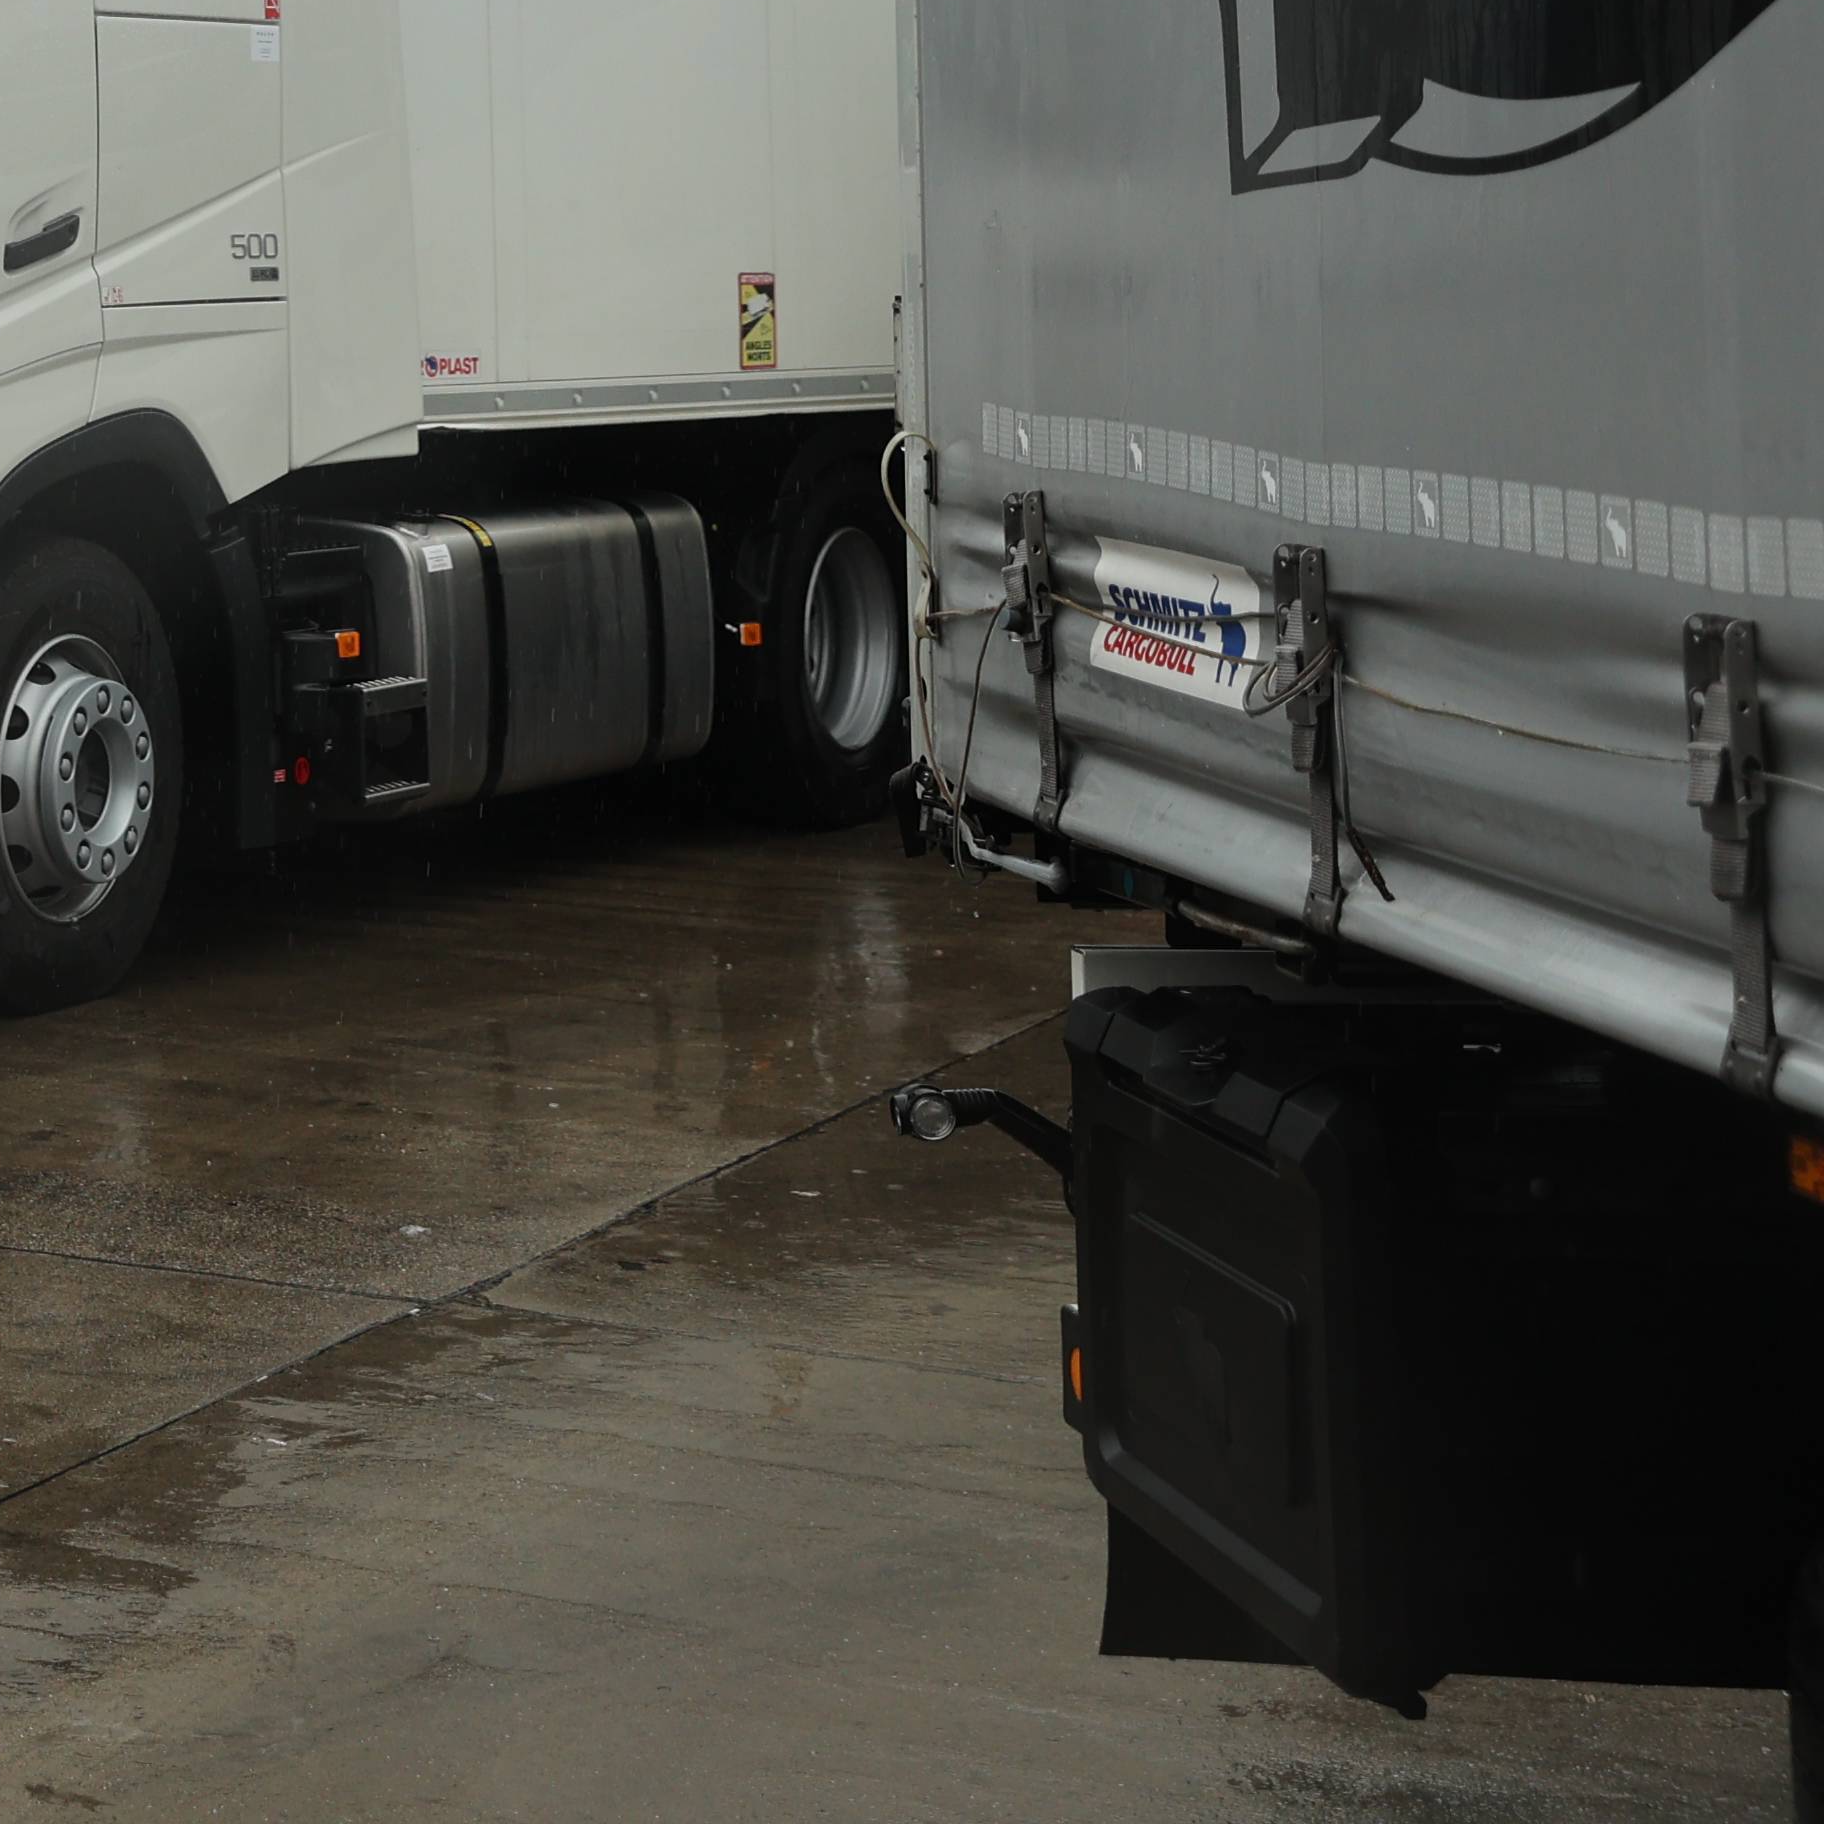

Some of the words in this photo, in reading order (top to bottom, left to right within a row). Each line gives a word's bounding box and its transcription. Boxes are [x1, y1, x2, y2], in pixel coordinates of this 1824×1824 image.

[230, 232, 279, 260] 500
[1108, 583, 1207, 643] SCHMITZ
[1103, 623, 1197, 676] CARGOBULL
